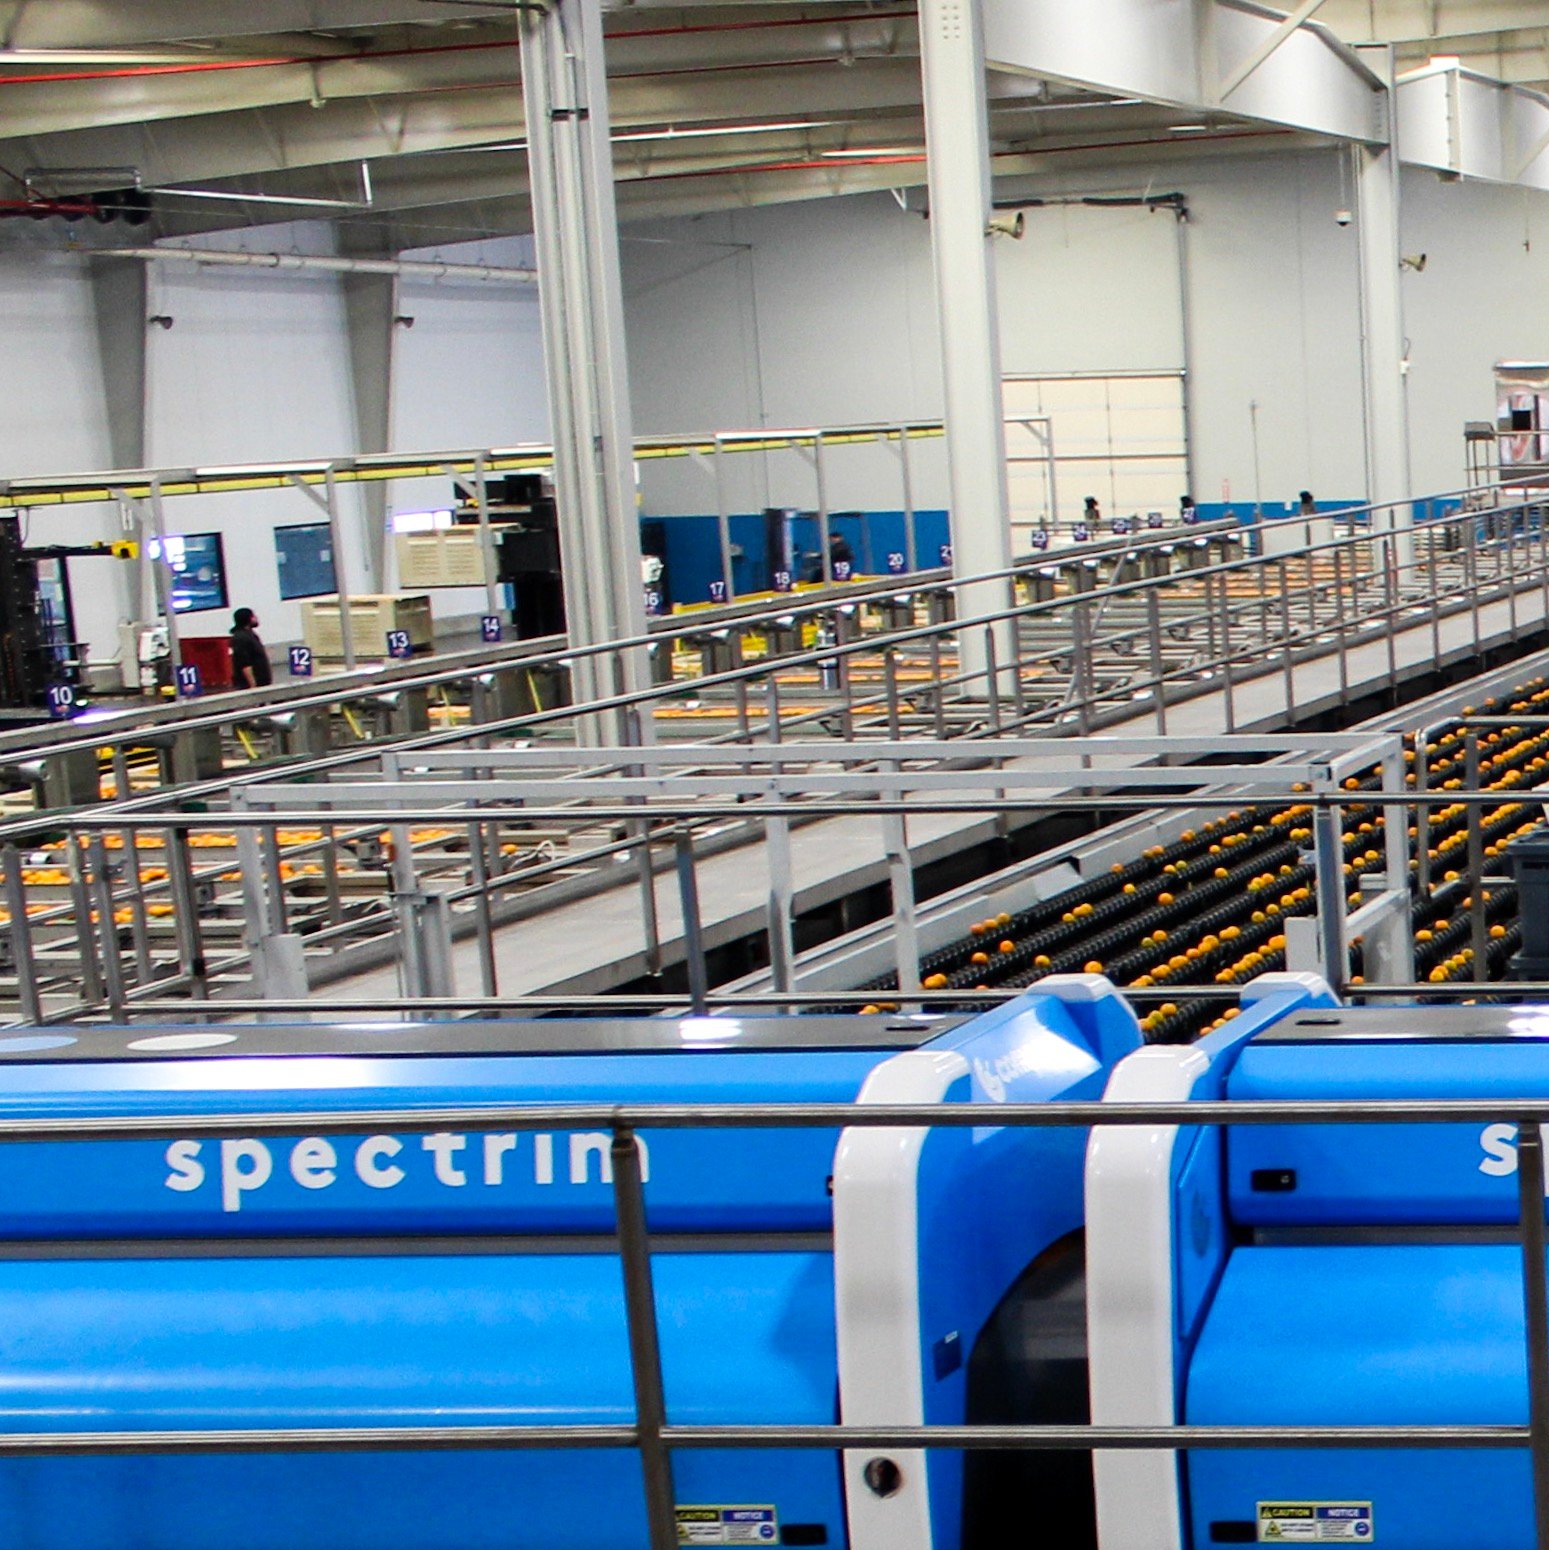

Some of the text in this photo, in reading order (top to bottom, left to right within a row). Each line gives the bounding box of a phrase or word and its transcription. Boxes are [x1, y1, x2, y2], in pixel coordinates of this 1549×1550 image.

[888, 552, 904, 567] 20
[834, 561, 850, 575] 19
[774, 571, 790, 585] 18
[709, 581, 725, 596] 17
[483, 617, 499, 633] 14
[389, 632, 409, 648] 13
[291, 648, 311, 665] 12
[179, 666, 196, 685] 11
[50, 686, 73, 705] 10
[164, 1131, 649, 1212] spectrim
[1272, 1508, 1310, 1517] CAUTION
[1327, 1508, 1360, 1517] NOTICE
